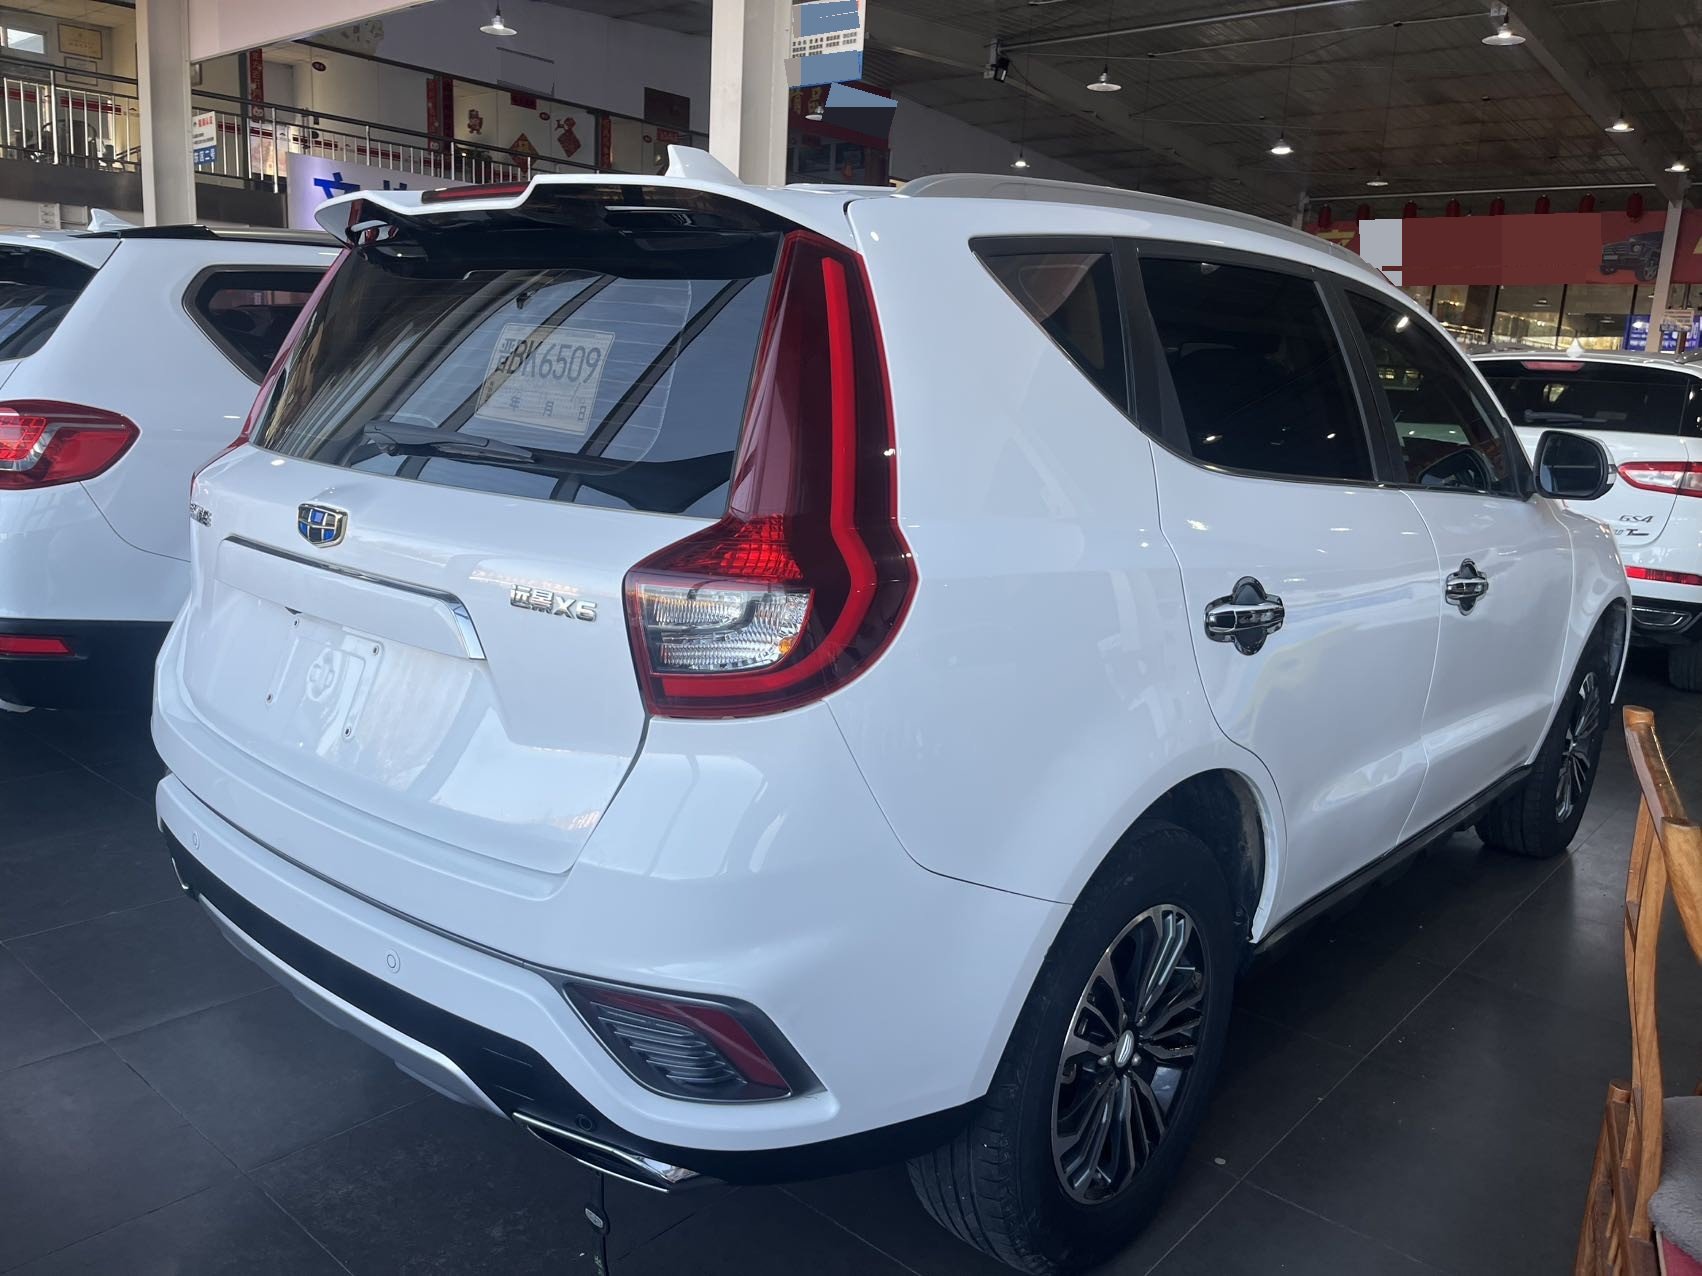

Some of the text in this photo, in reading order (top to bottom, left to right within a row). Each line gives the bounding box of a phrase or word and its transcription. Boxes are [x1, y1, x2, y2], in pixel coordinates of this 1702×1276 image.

[543, 401, 554, 417] 月
[578, 405, 587, 422] 日
[1619, 514, 1654, 524] GS4
[509, 583, 598, 622] 远景X6
